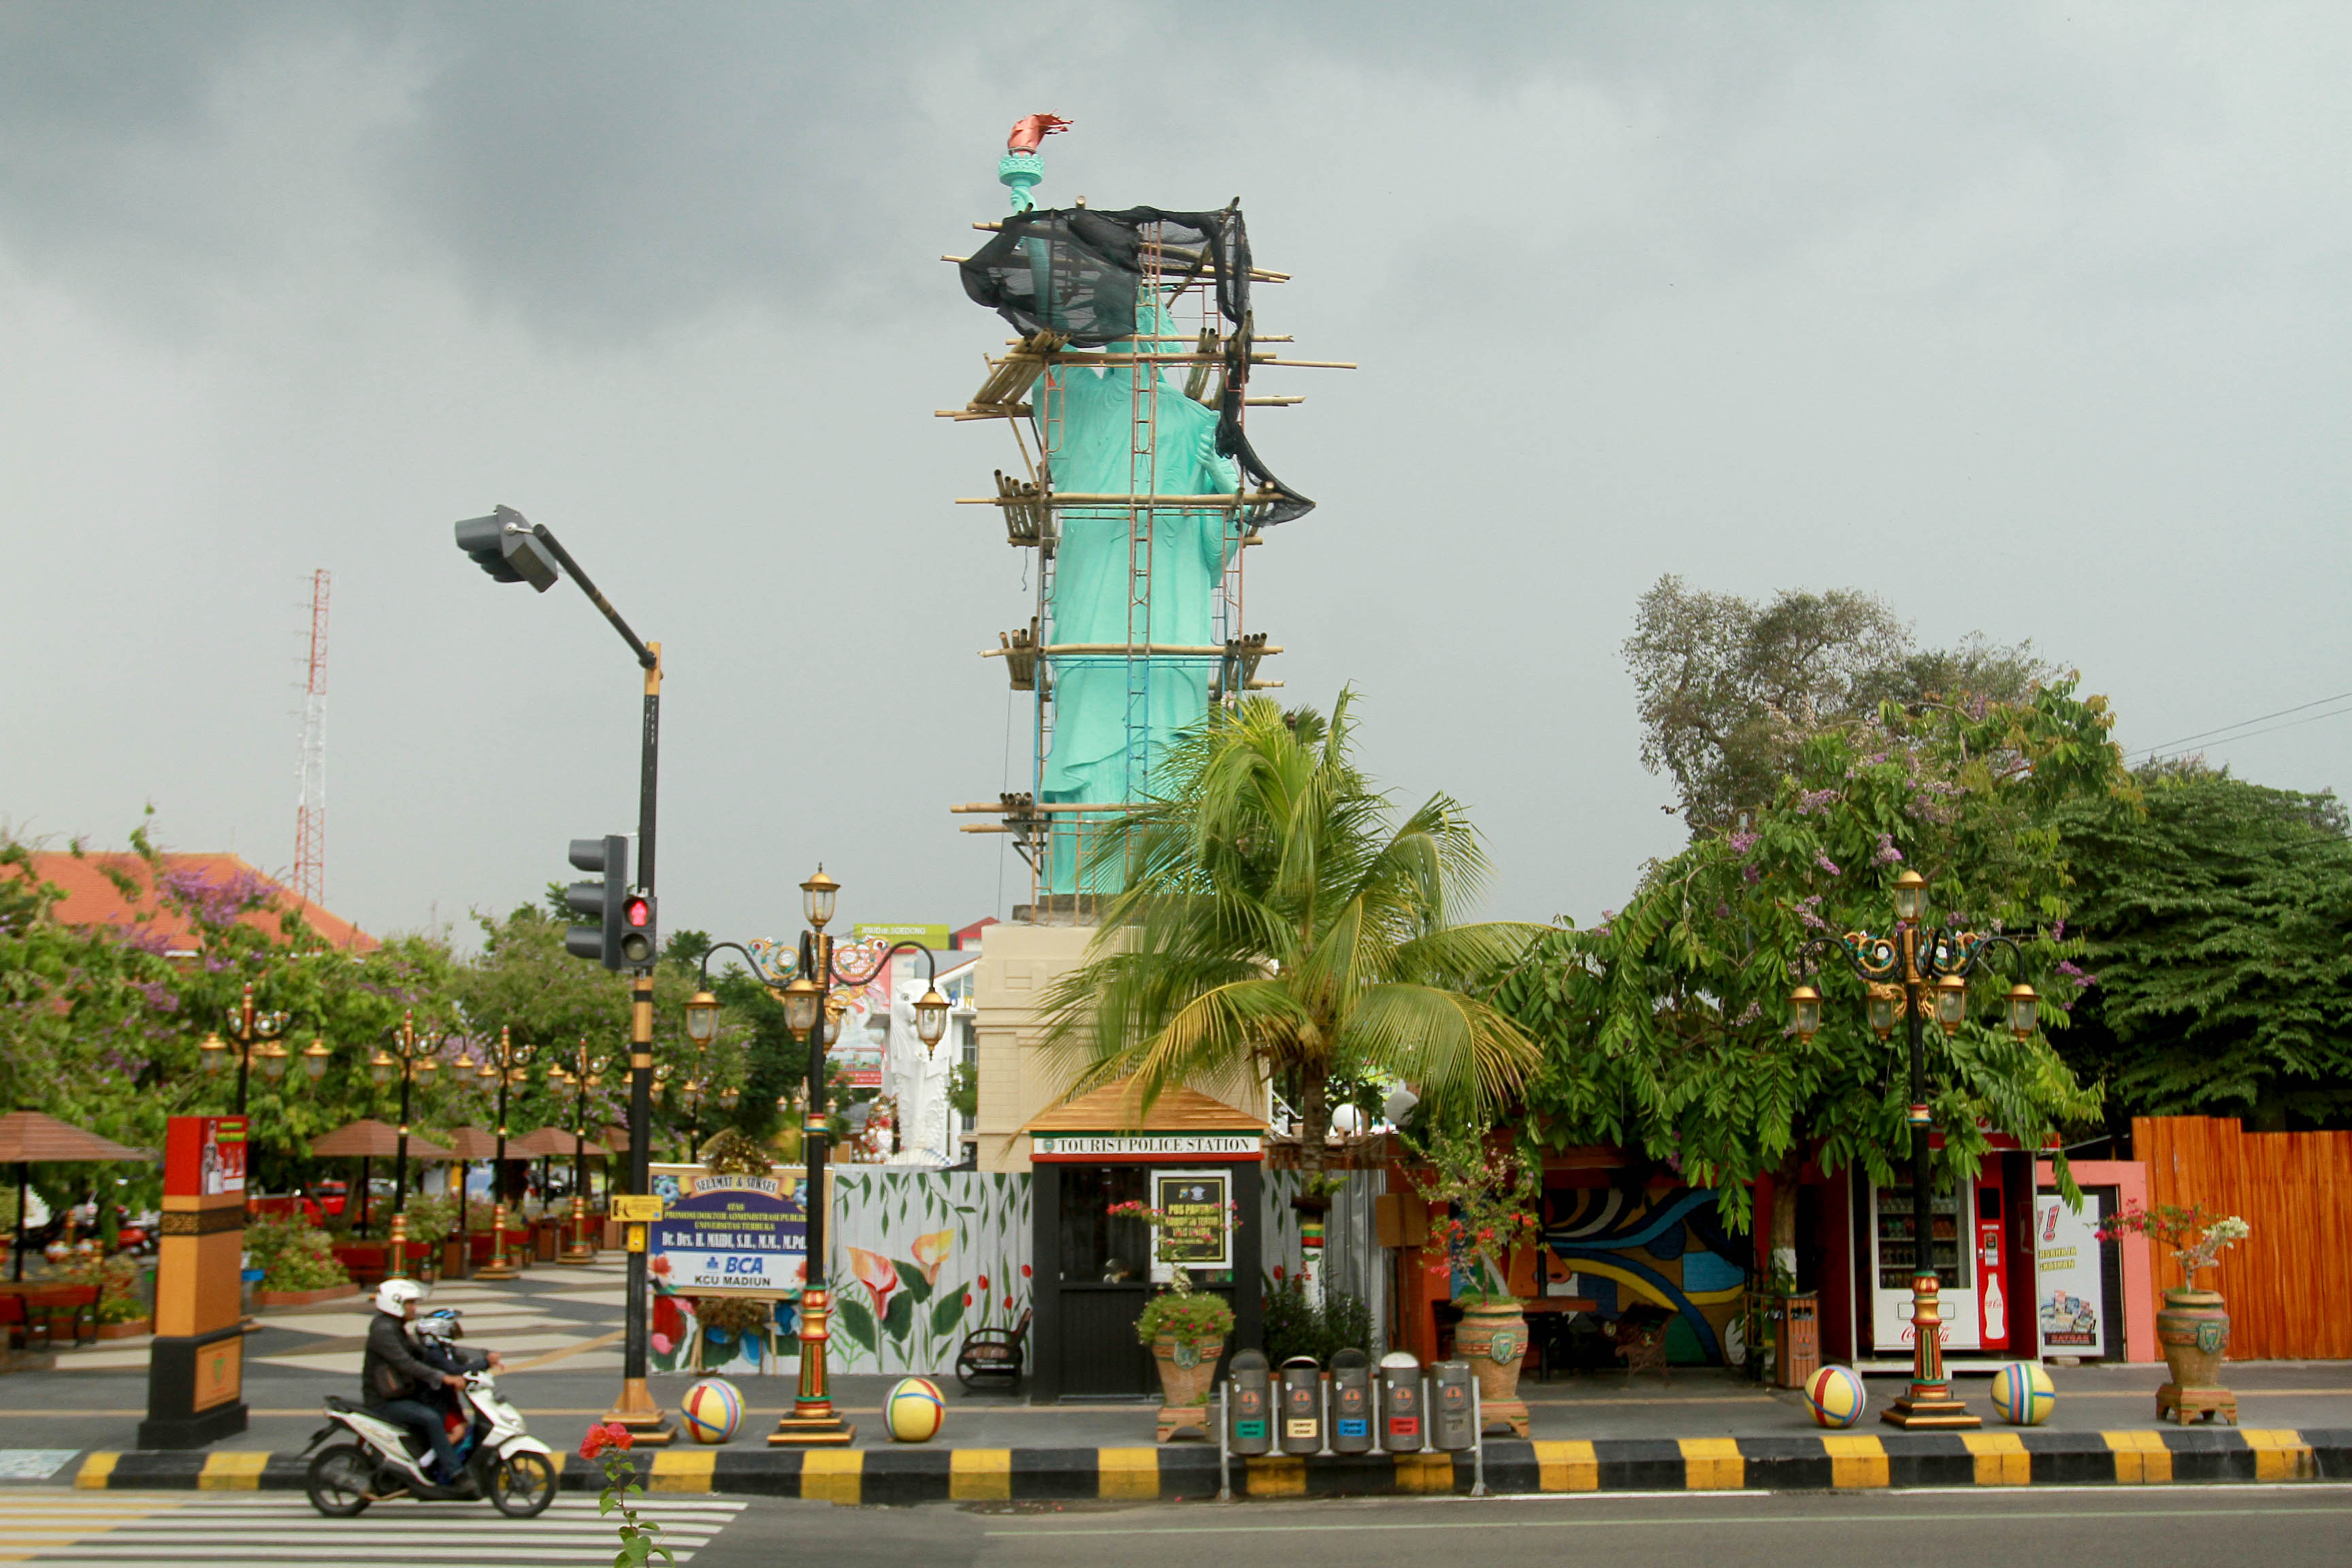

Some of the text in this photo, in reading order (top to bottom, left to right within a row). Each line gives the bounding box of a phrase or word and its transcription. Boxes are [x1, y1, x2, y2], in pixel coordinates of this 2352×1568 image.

[1058, 1139, 1250, 1152] TOURIST POLICE STATION
[696, 1176, 778, 1192] SELAMAT & SUKSES
[662, 1231, 674, 1246] Dr.
[676, 1231, 693, 1247] Drs.
[725, 1256, 764, 1274] BCA
[694, 1275, 770, 1286] KCU MADIUN
